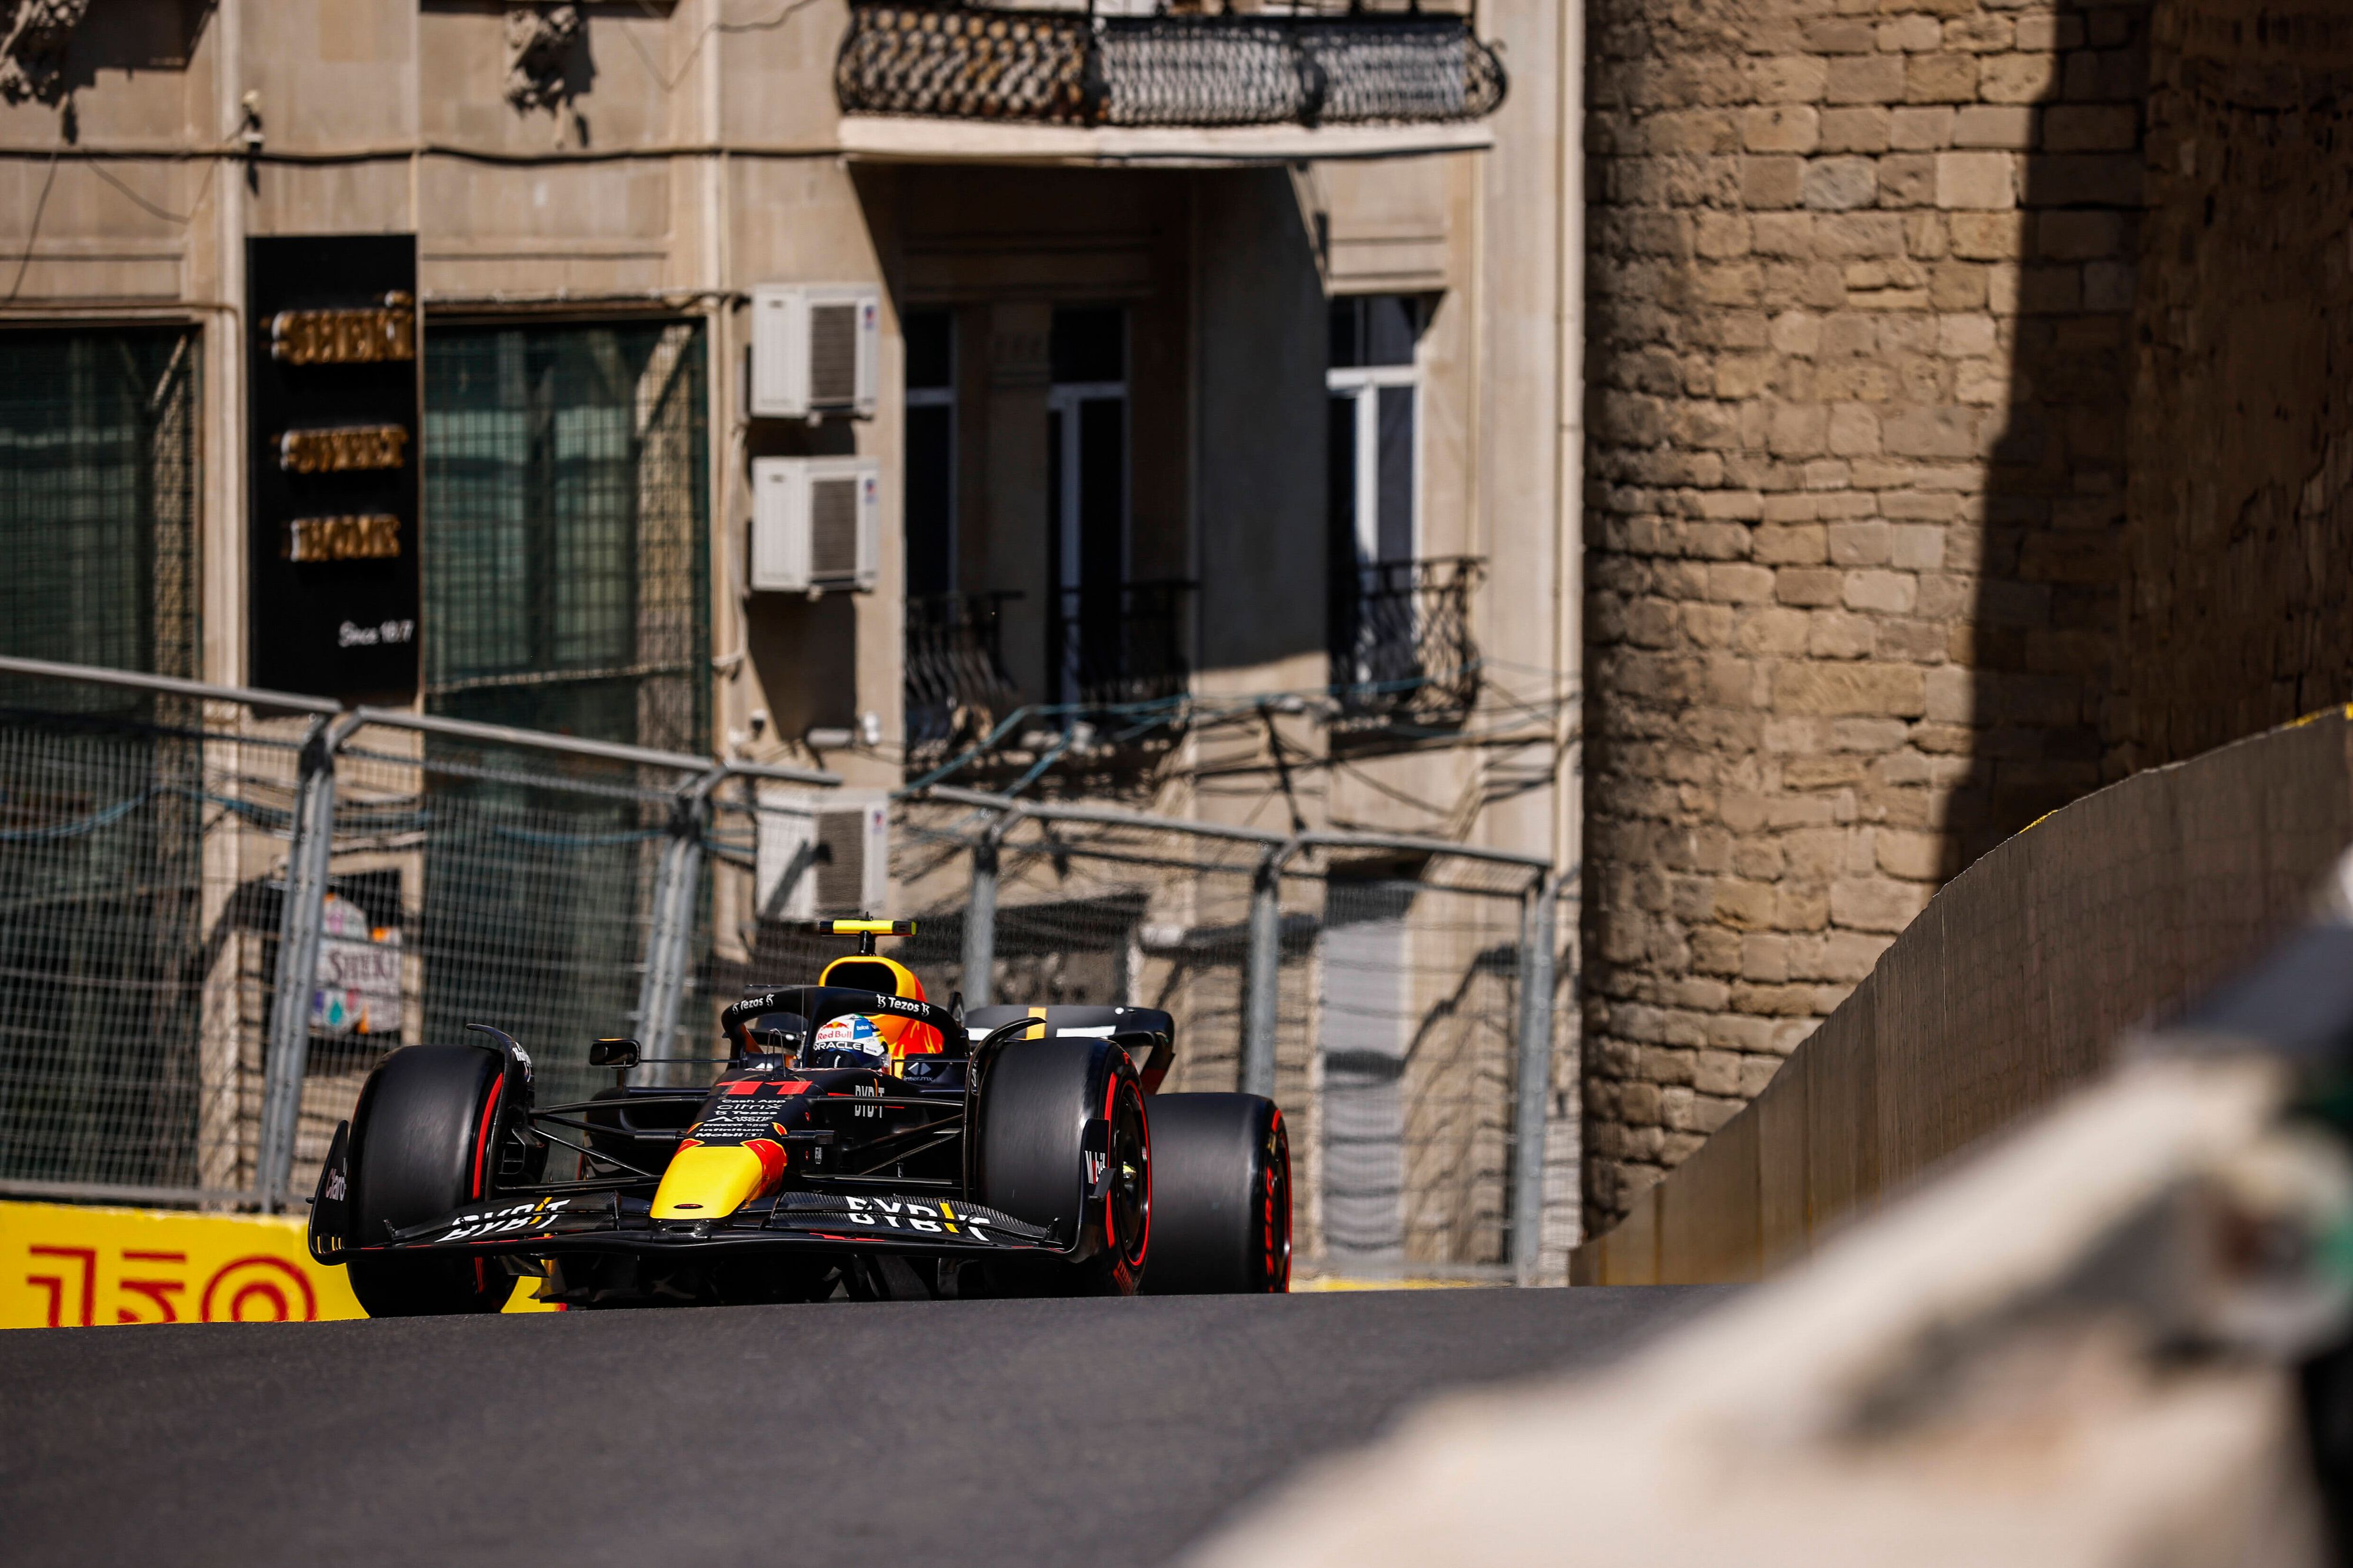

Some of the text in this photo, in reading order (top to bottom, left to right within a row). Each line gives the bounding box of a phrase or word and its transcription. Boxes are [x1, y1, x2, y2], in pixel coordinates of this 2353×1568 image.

[740, 998, 764, 1010] Tezos
[888, 997, 919, 1012] Tezos
[818, 1031, 834, 1040] Red
[812, 1042, 862, 1051] ORACLE
[715, 1081, 813, 1095] 11
[325, 1168, 346, 1201] Claro
